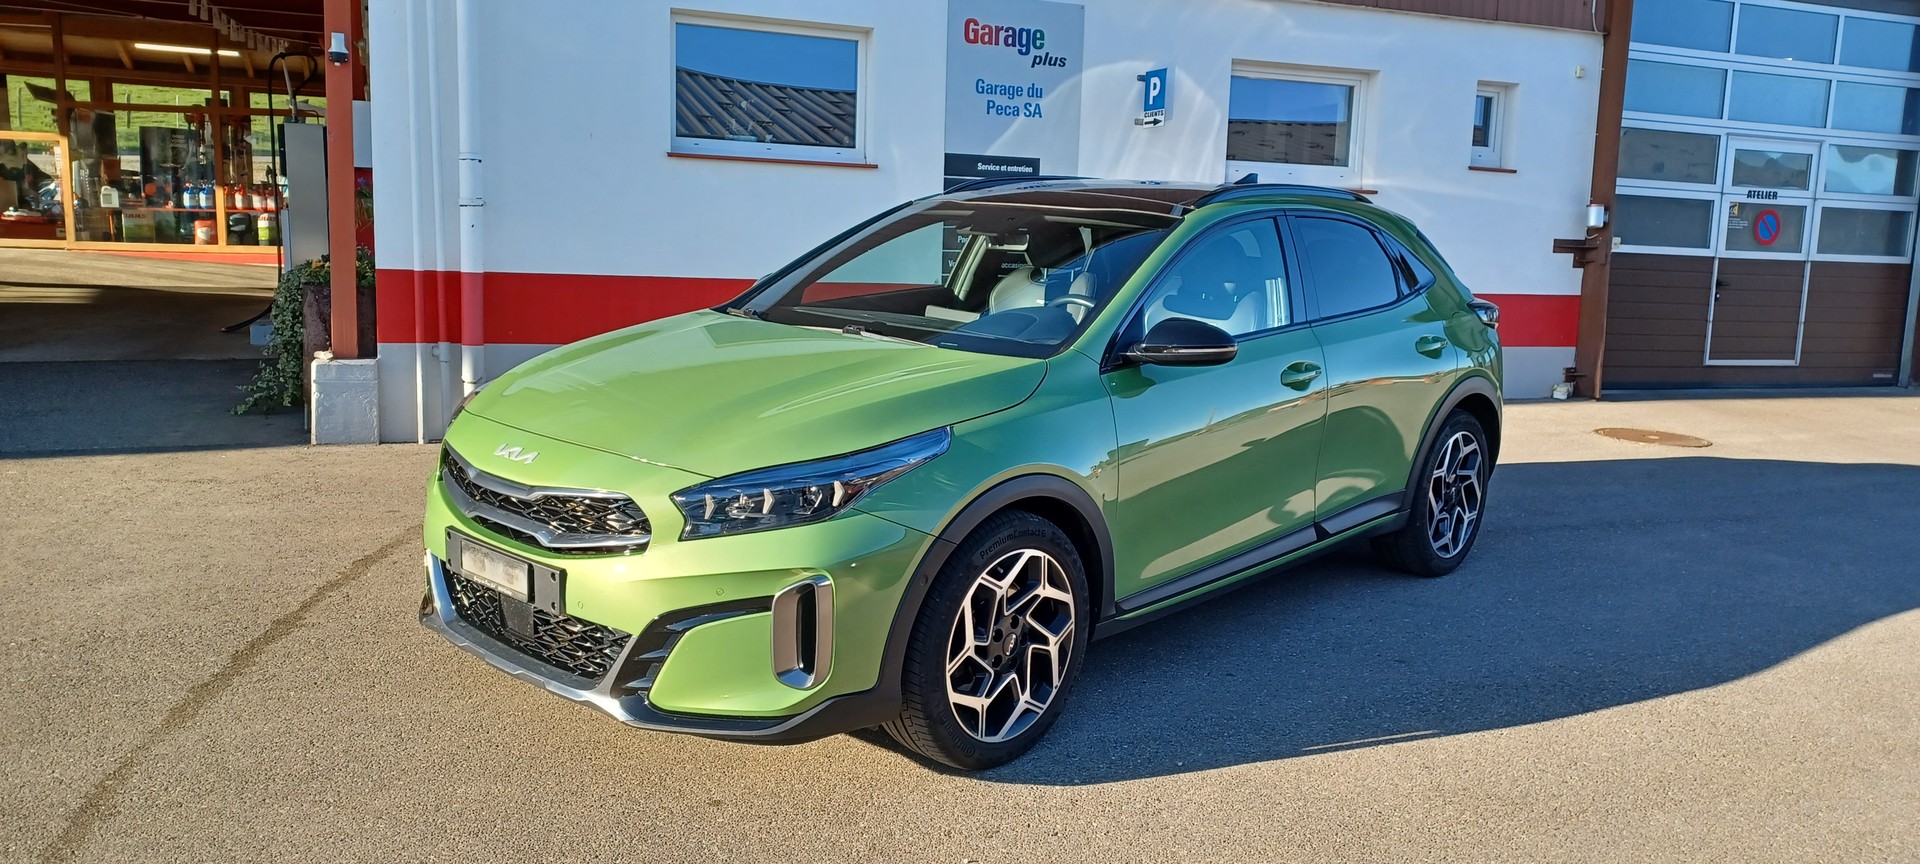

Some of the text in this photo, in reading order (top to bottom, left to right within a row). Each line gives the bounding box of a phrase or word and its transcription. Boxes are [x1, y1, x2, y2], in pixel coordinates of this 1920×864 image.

[964, 18, 1045, 56] Garage
[1031, 52, 1067, 68] plus
[975, 78, 1043, 100] Garage du
[1149, 76, 1161, 105] P
[986, 100, 1043, 118] Peca SA
[1144, 110, 1164, 118] CLIENTS
[977, 162, 1000, 171] Service
[1007, 165, 1033, 173] entretien
[1746, 190, 1778, 200] ATELIER
